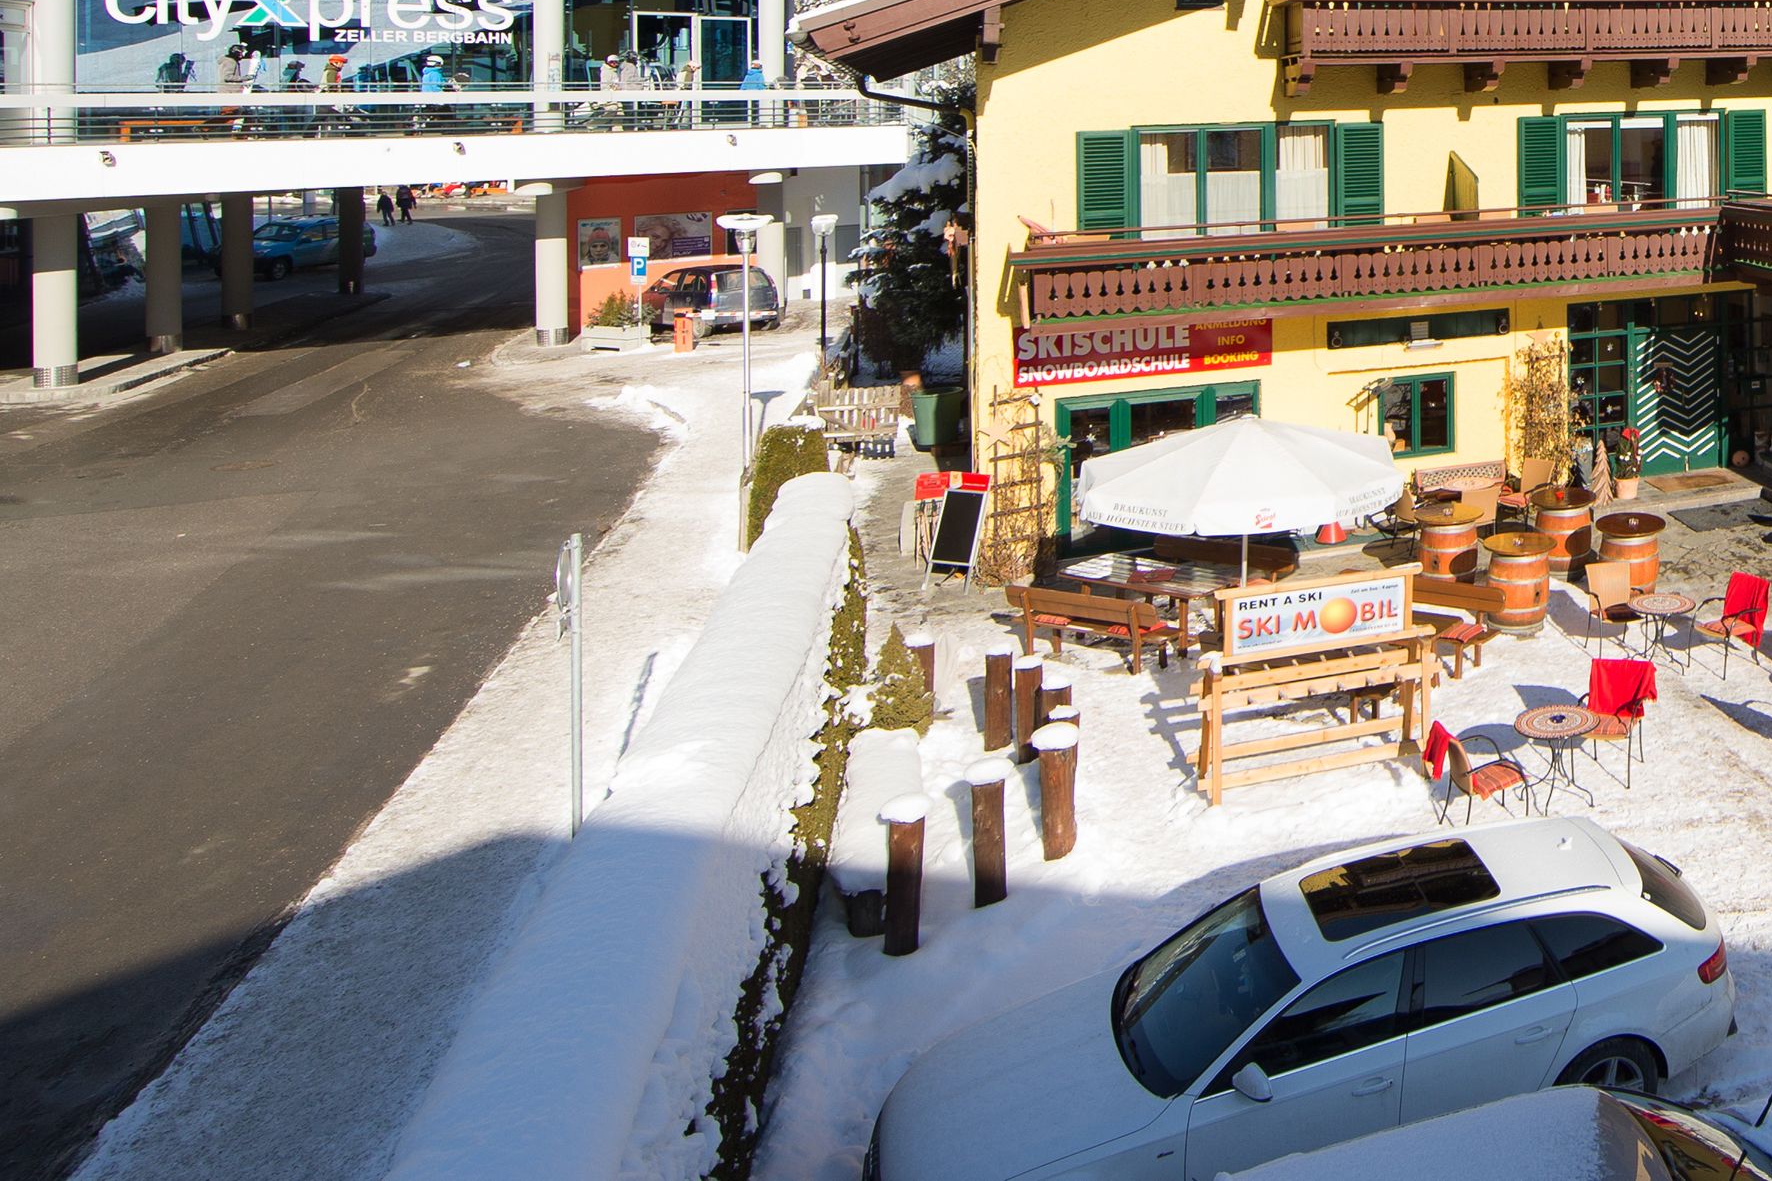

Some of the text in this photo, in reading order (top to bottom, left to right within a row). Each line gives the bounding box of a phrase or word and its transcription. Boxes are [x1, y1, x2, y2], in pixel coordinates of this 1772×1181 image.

[334, 29, 513, 45] ZELLER BERGBAHN
[634, 258, 645, 276] P
[1018, 325, 1191, 360] SKISCHULE
[1217, 334, 1246, 346] INFO
[1203, 350, 1259, 365] BOOKING
[1018, 353, 1191, 384] SNOWBOARDSCHULE
[1239, 591, 1323, 611] RENT A SKI
[1237, 614, 1281, 640] SKI
